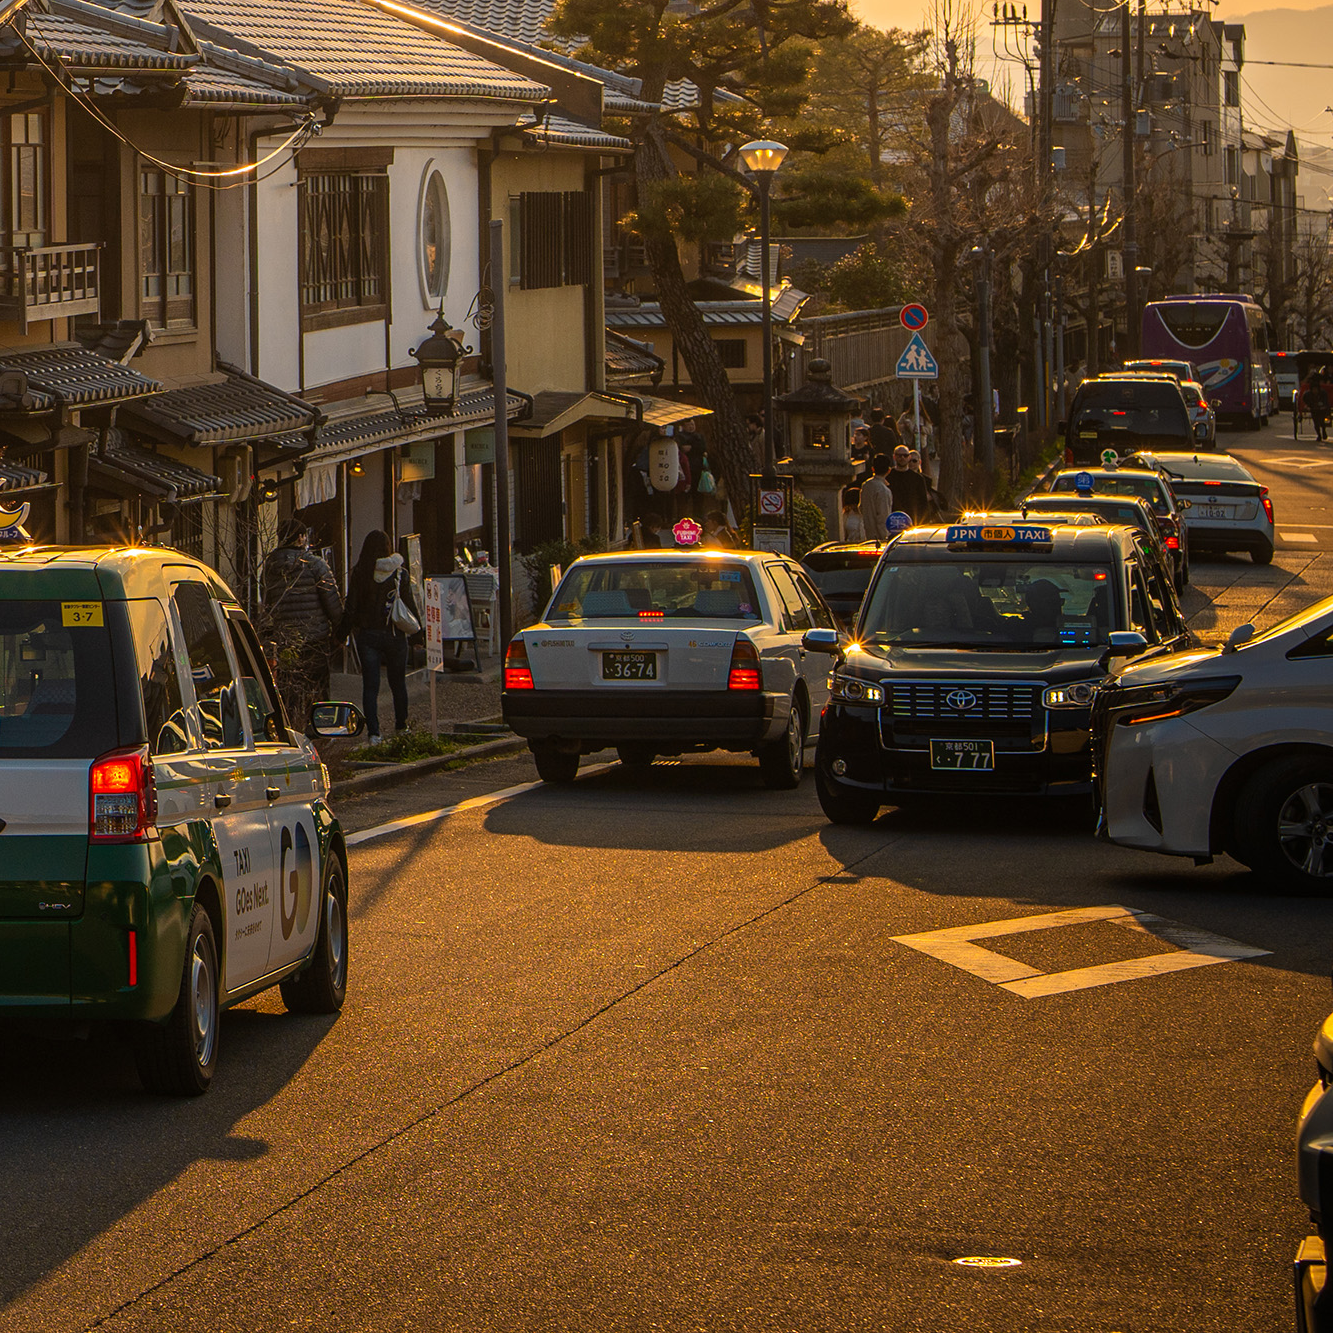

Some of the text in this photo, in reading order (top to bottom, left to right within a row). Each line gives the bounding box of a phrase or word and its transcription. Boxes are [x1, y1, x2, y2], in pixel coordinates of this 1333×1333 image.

[952, 529, 1045, 540] JPN 市個人 TAXI
[614, 663, 654, 677] 36-74
[233, 847, 251, 877] TAXI
